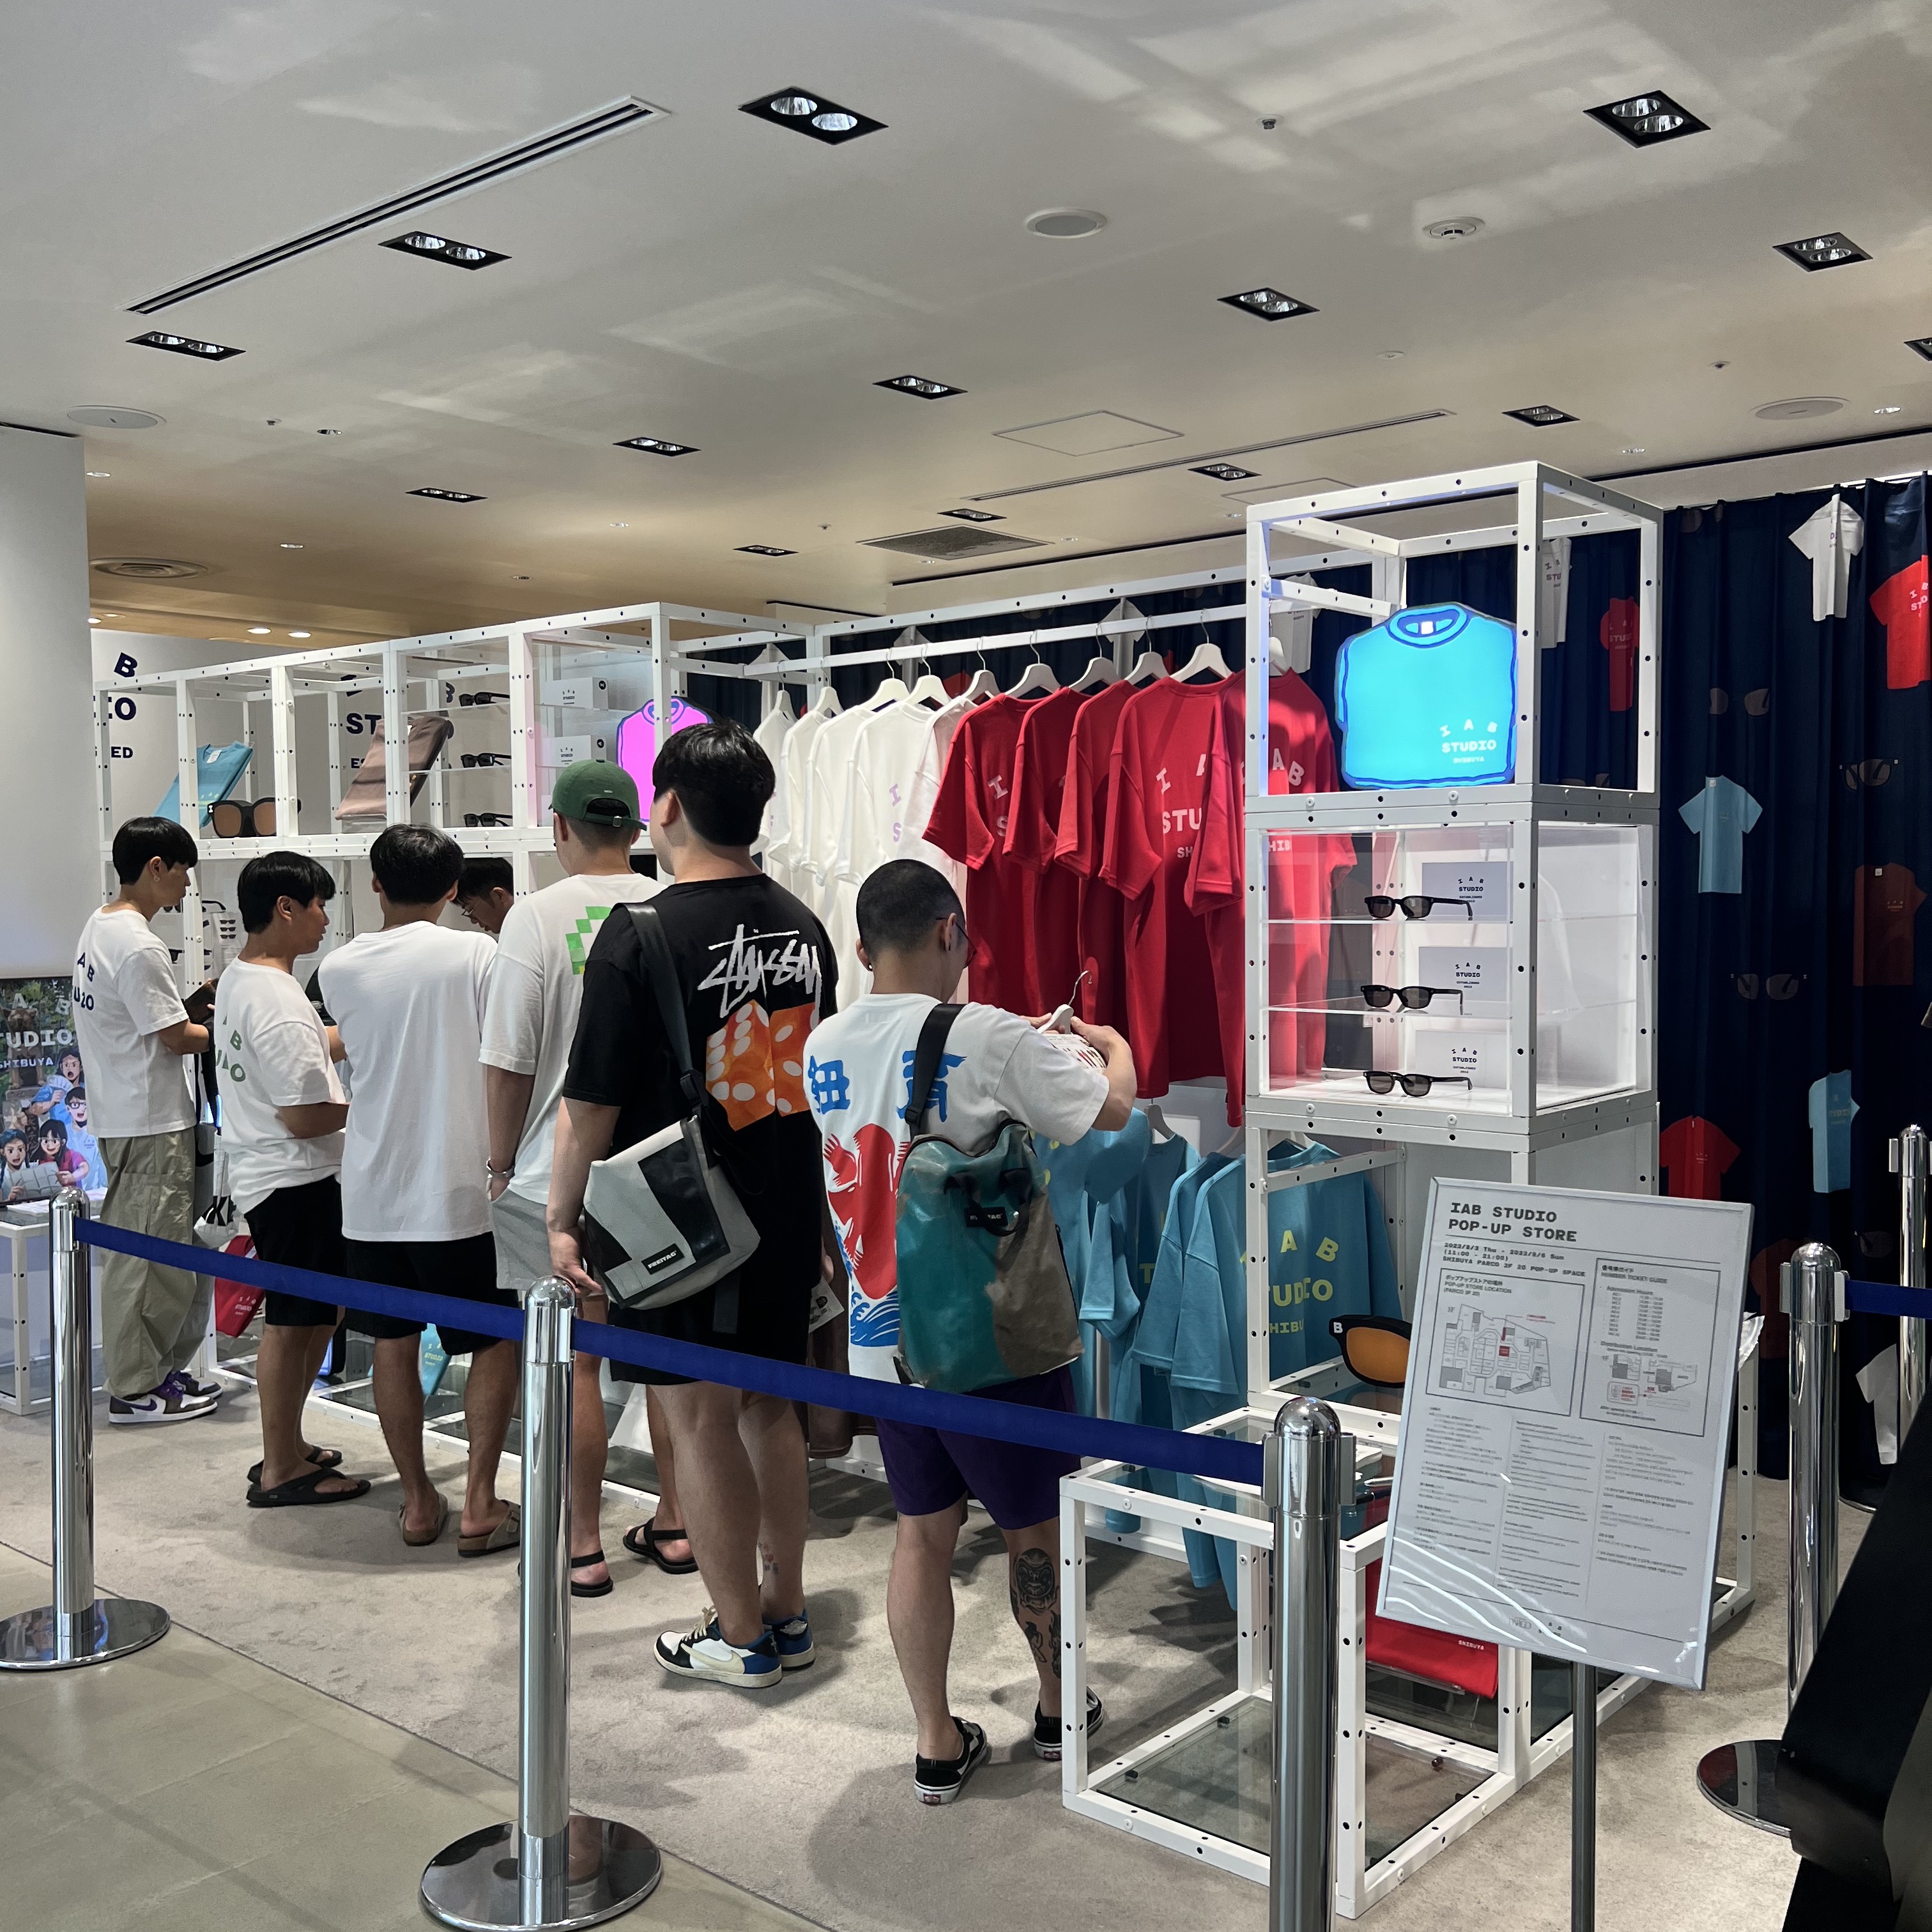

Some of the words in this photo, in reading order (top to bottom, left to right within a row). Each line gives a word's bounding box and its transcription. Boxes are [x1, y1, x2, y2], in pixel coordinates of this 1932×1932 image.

[1441, 739, 1497, 753] STUDIO
[1450, 1202, 1482, 1215] IAB
[1492, 1206, 1557, 1223] STUDIO
[1448, 1218, 1512, 1235] POP-UP
[1522, 1226, 1577, 1242] STORE
[647, 1250, 677, 1269] FREITAG
[1443, 1255, 1473, 1264] SHIBUYA
[1563, 1269, 1586, 1277] SPACE
[1459, 1640, 1484, 1650] SHIBUYA
